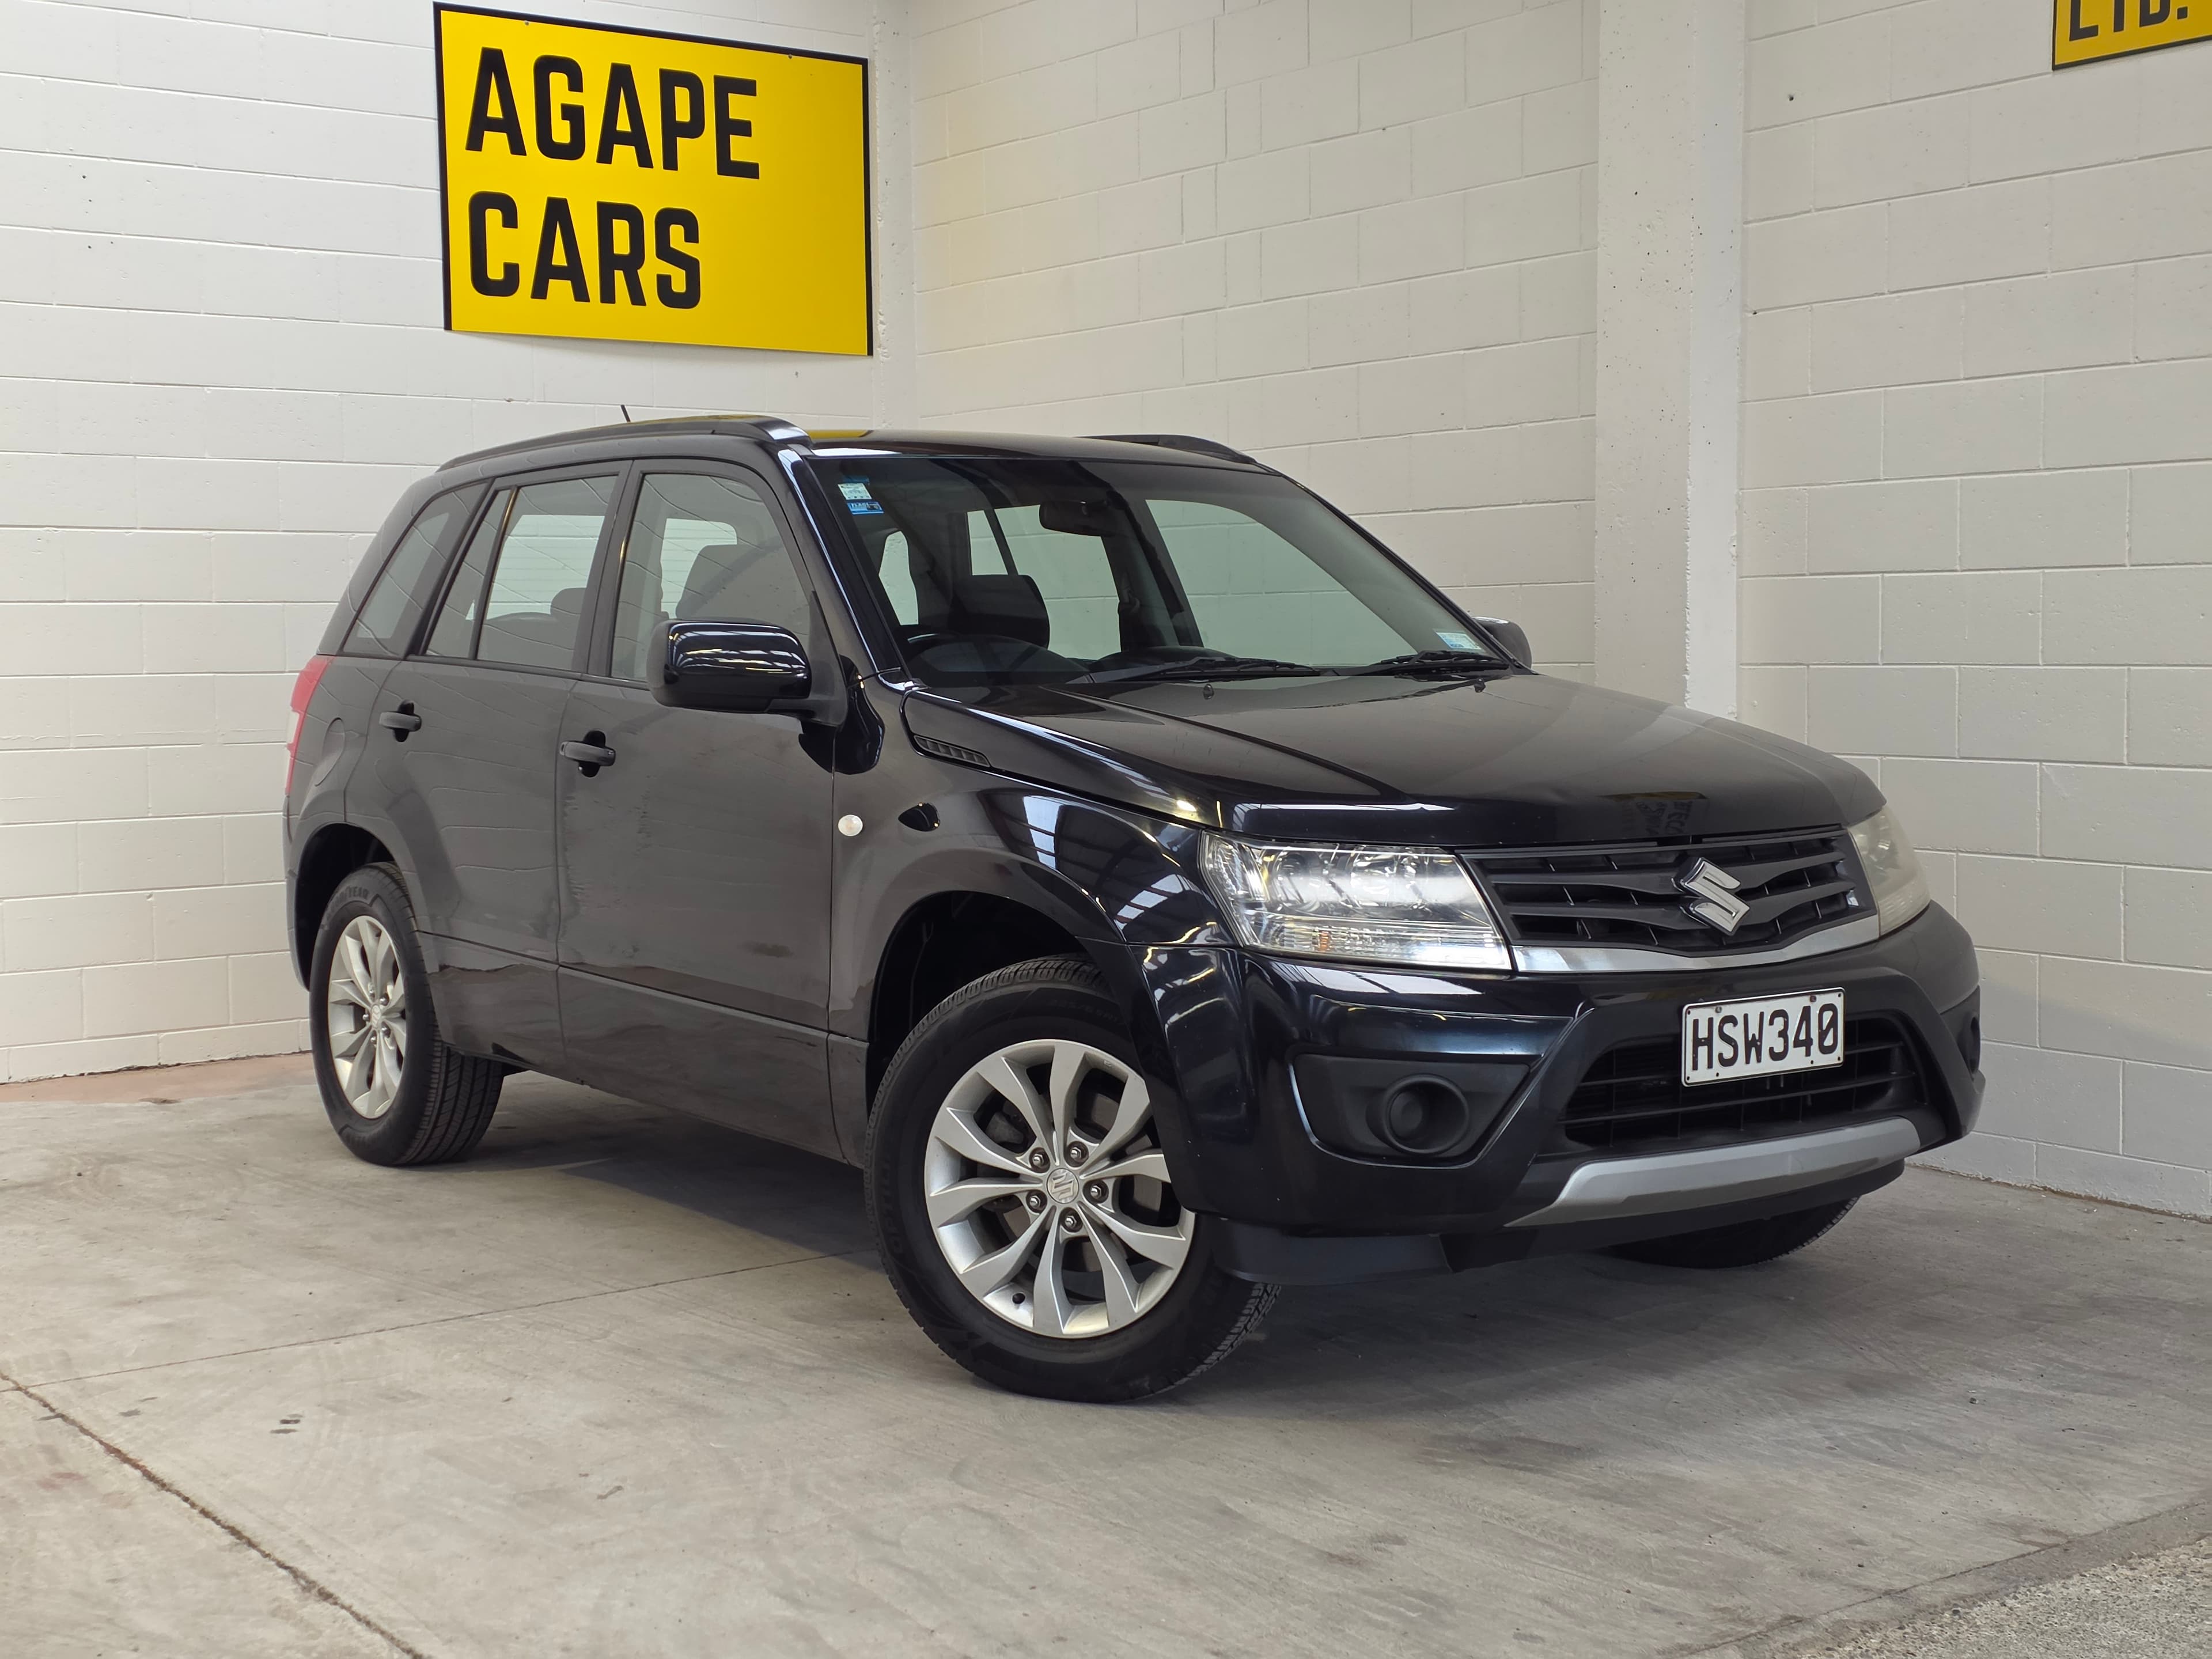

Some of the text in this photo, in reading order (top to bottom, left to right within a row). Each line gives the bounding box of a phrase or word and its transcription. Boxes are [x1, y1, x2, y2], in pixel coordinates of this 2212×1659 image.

[465, 47, 760, 179] AGAPE
[468, 191, 701, 309] CARS
[1692, 1003, 1839, 1071] HSW340
